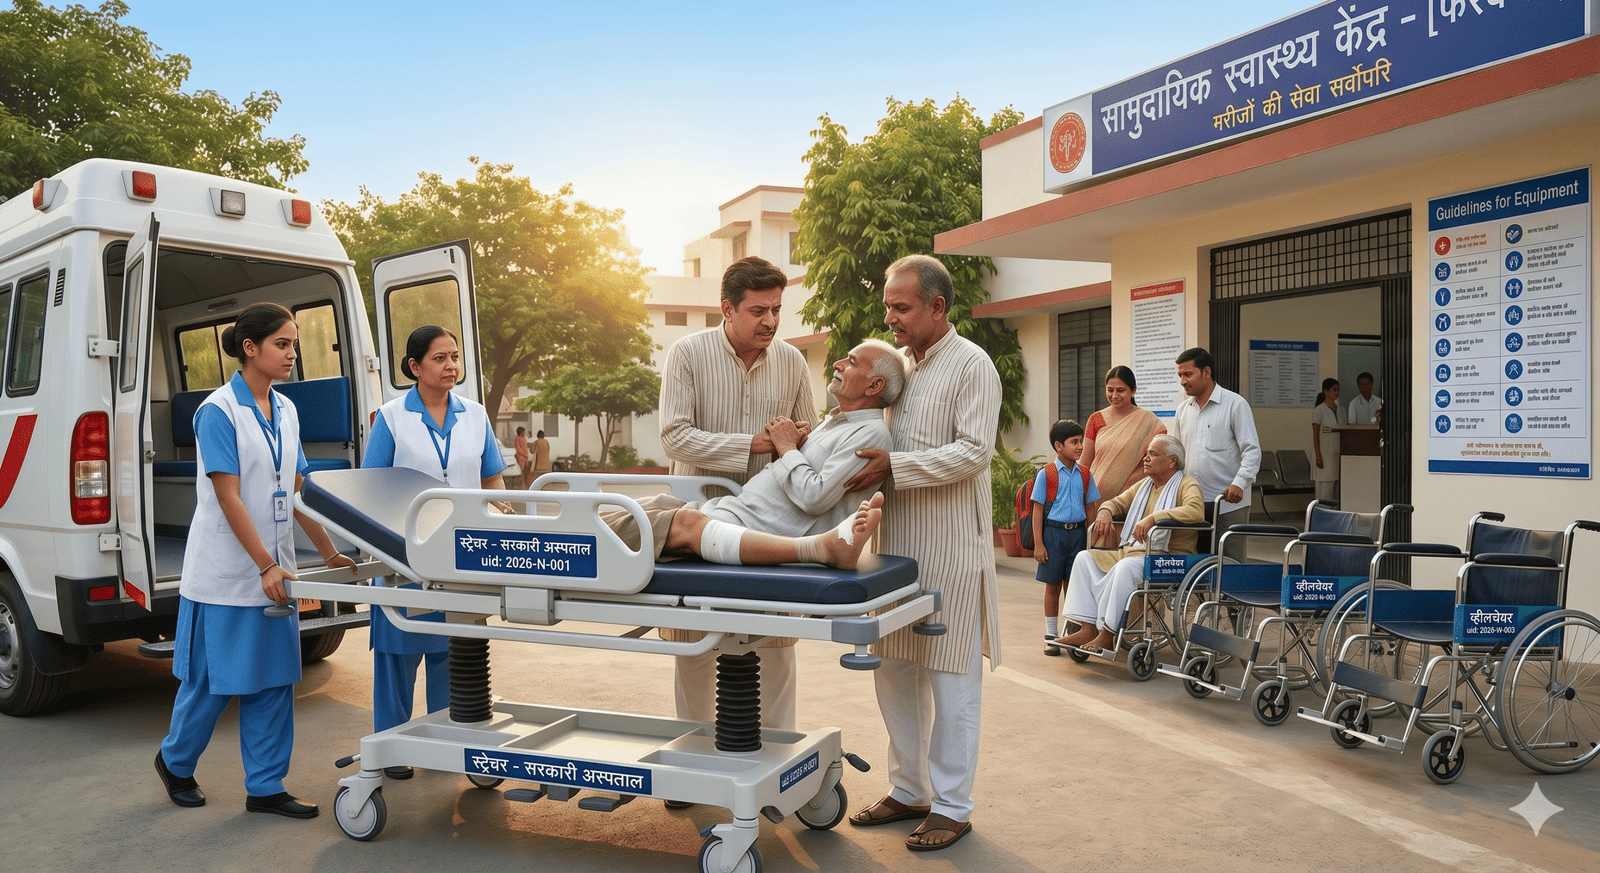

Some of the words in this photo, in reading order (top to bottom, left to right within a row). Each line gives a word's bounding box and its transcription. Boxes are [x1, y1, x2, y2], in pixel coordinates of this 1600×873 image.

[1100, 69, 1212, 140] सामुदायिक
[1223, 30, 1320, 94] स्वास्थ्य
[1333, 4, 1389, 57] केंद्र
[1213, 98, 1255, 131] मरीजों
[1262, 90, 1282, 117] की
[1289, 83, 1321, 110] सेवा
[1328, 57, 1392, 98] सर्वोपरि
[1436, 200, 1492, 221] Guidelines
[1495, 195, 1511, 210] for
[1514, 180, 1579, 208] Equipment
[459, 534, 488, 552] स्ट्रेचर
[500, 537, 540, 553] सरकारी
[544, 541, 591, 556] अस्पताल
[481, 555, 502, 567] uid:
[506, 556, 570, 572] 2026-N-001
[1466, 626, 1479, 634] uid:
[1480, 626, 1516, 634] 2026-W-003
[1469, 609, 1514, 625] व्हीलचेयर
[471, 752, 509, 773] स्ट्रेचर
[524, 761, 578, 781] सरकारी
[582, 768, 644, 789] अस्पताल
